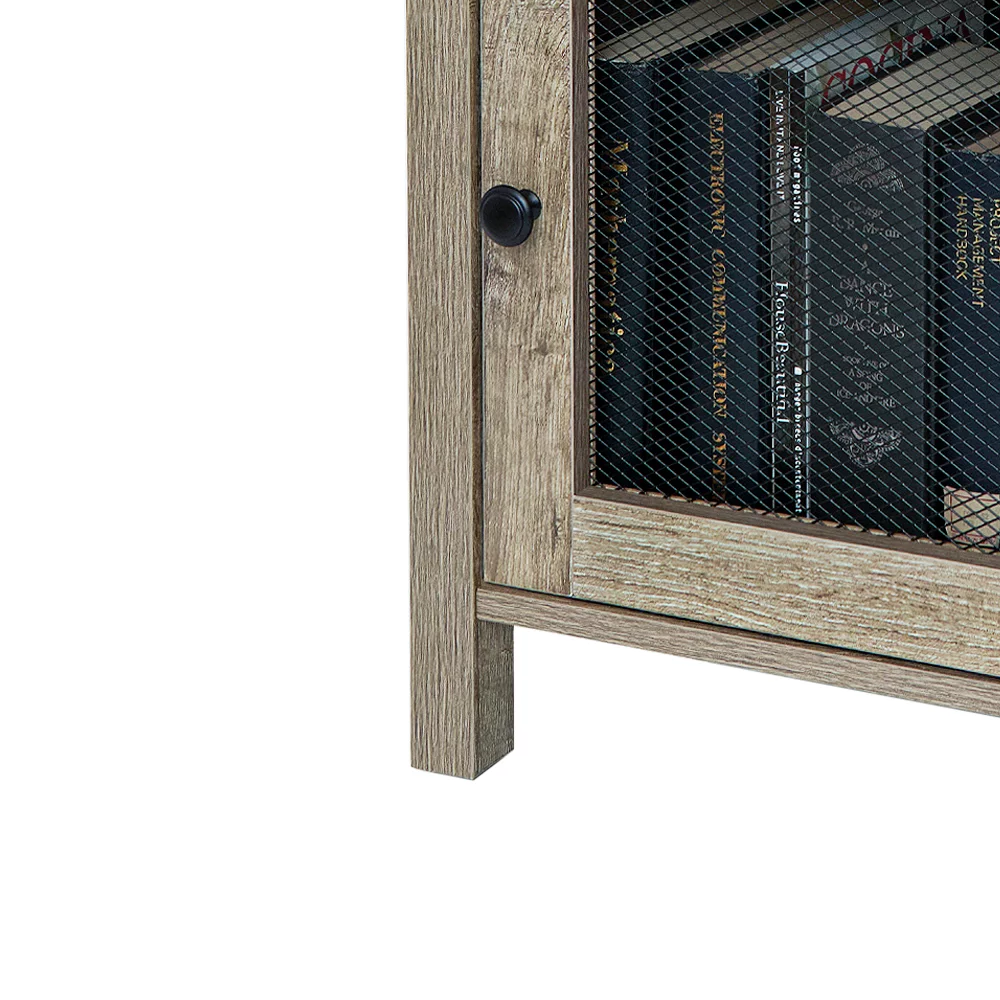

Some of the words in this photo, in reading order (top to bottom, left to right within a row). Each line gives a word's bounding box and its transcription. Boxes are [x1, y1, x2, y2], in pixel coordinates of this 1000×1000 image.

[709, 111, 726, 238] ELECTRONIC
[956, 195, 969, 281] HANDBOOK
[972, 197, 985, 309] MANAGEMENT
[711, 249, 728, 419] COMMUNICATION
[829, 312, 906, 339] DRAGONS
